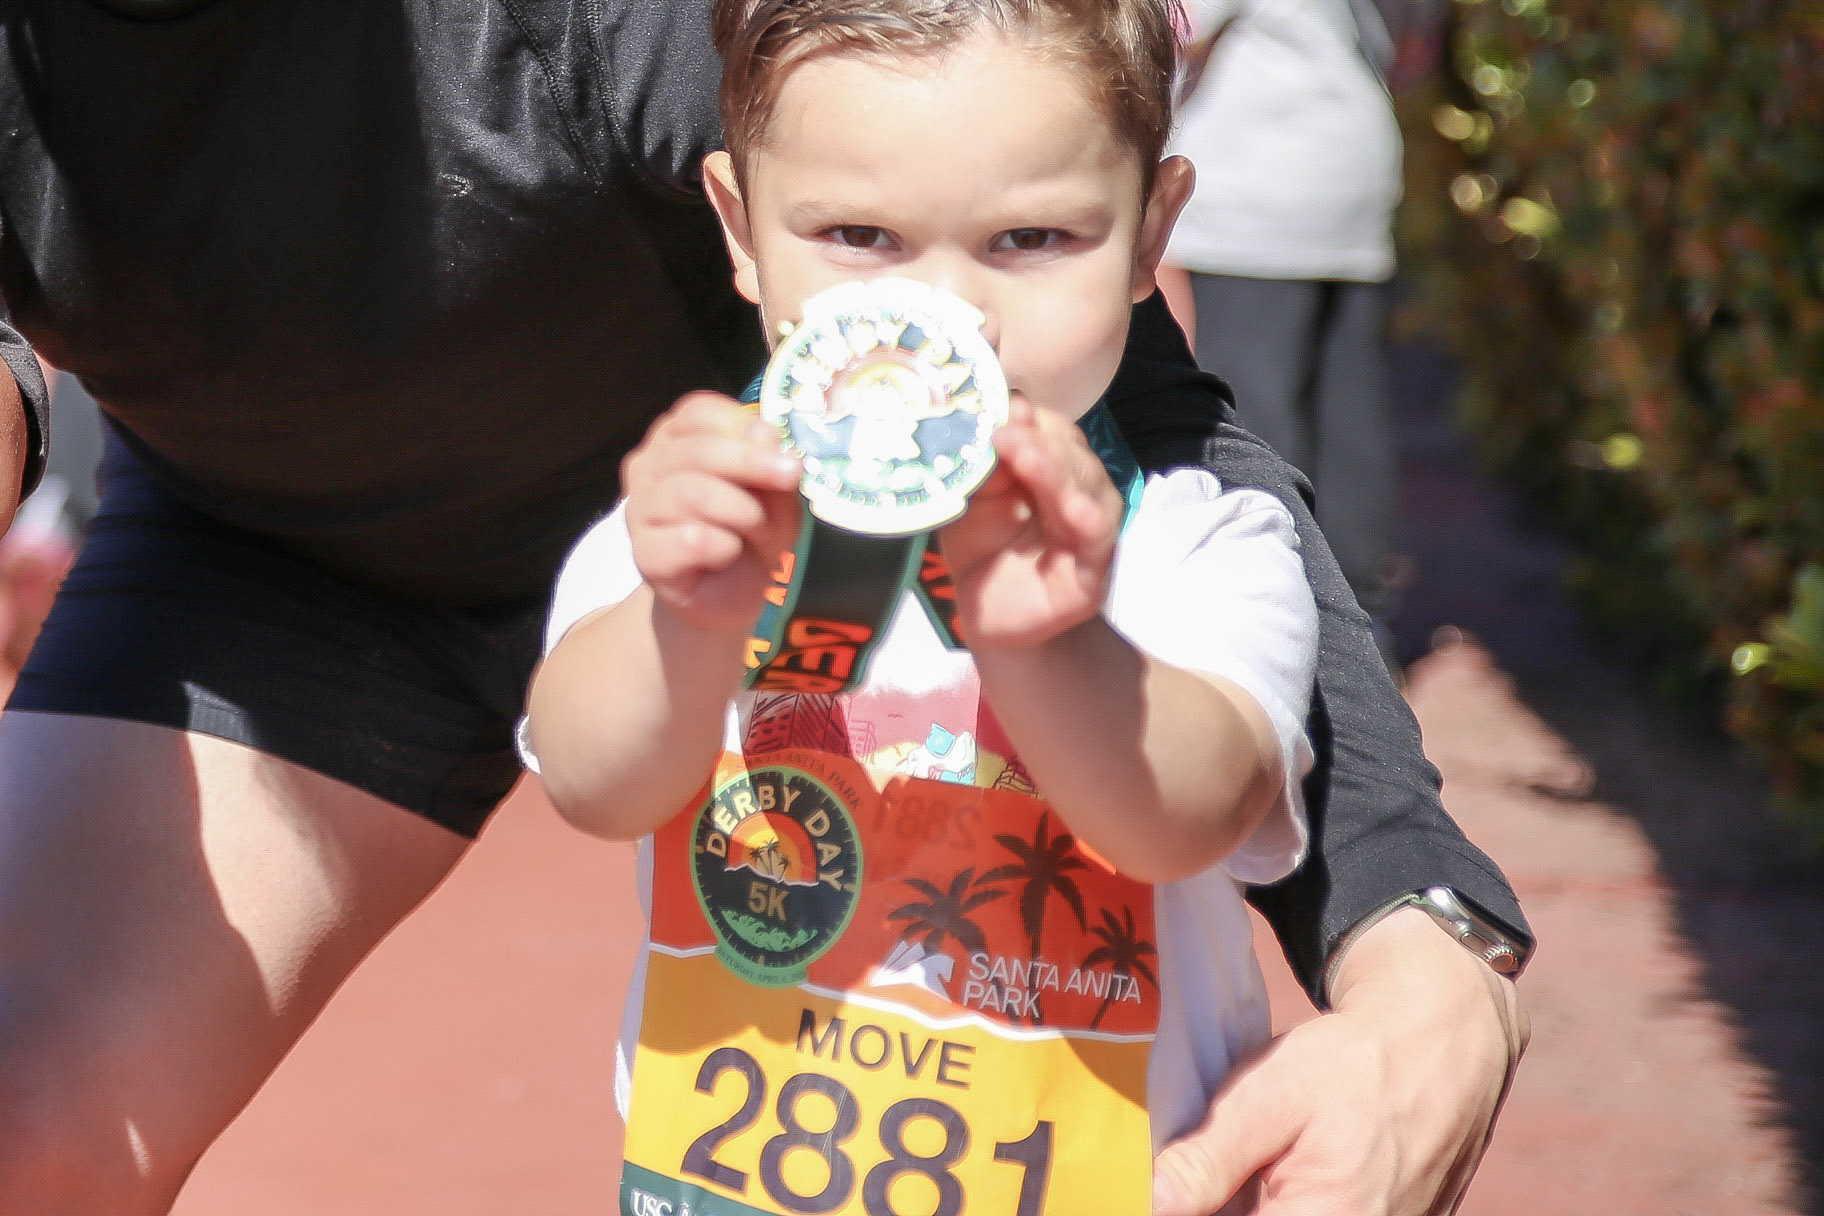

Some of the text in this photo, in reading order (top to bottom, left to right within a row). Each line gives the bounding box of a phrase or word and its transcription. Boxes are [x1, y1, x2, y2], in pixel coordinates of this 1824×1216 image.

[706, 784, 845, 892] DERBY DAY
[748, 880, 790, 921] 5K
[962, 980, 1041, 1019] PARK
[968, 952, 1142, 1005] SANTA ANITA
[796, 1008, 977, 1091] MOVE
[679, 1046, 1056, 1216] 2881
